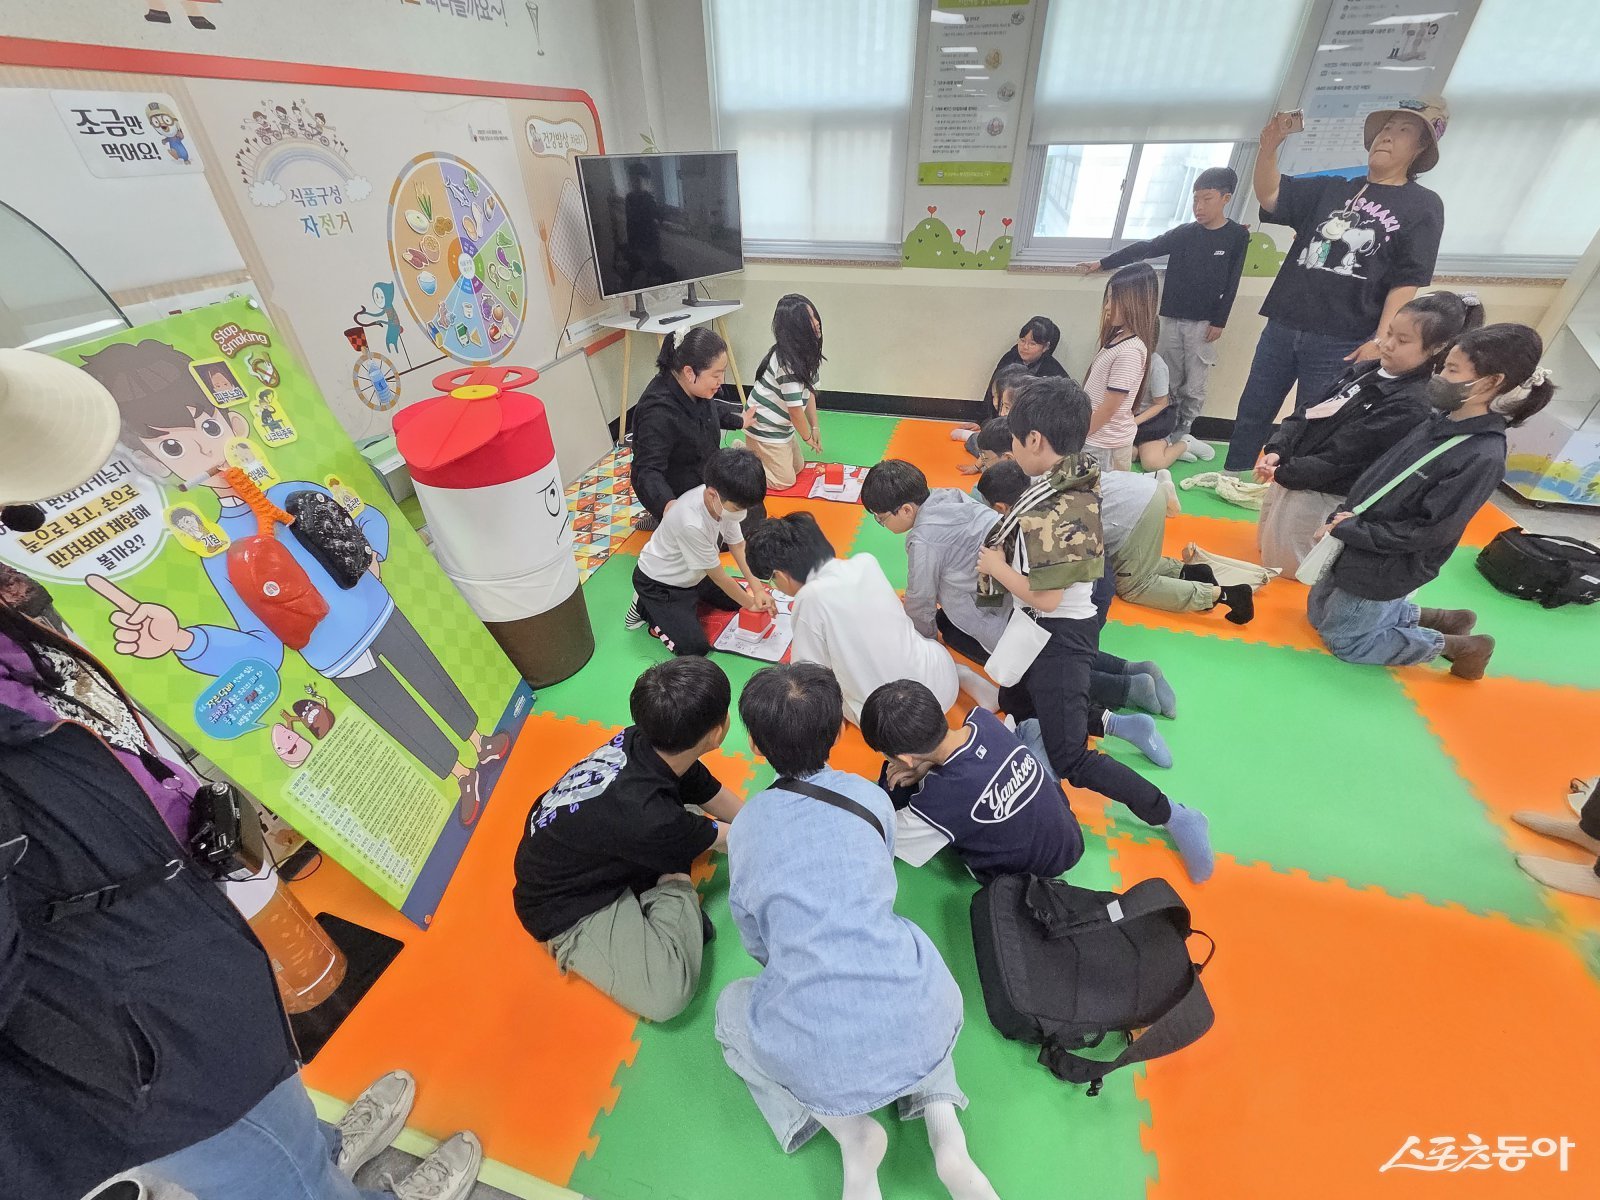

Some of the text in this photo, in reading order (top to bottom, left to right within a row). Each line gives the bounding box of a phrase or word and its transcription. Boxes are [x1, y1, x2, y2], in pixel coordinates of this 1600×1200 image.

[70, 108, 145, 137] 조금만
[542, 131, 570, 149] 건강밥상
[101, 142, 162, 163] 먹어요!
[290, 184, 342, 207] 식품구성
[300, 211, 353, 238] 자전거
[213, 323, 239, 344] Stop
[221, 332, 268, 356] Smoking
[213, 386, 245, 403] 피부노화
[264, 426, 295, 442] 니코틴중독
[247, 465, 269, 481] 입냄새
[19, 521, 69, 554] 눈으로
[64, 506, 102, 529] 보고,
[100, 483, 140, 512] 손으로
[46, 503, 151, 569] 만져보며 체험해
[201, 534, 221, 548] 기침
[96, 533, 147, 571] 볼까요?
[980, 753, 1037, 820] Yankees
